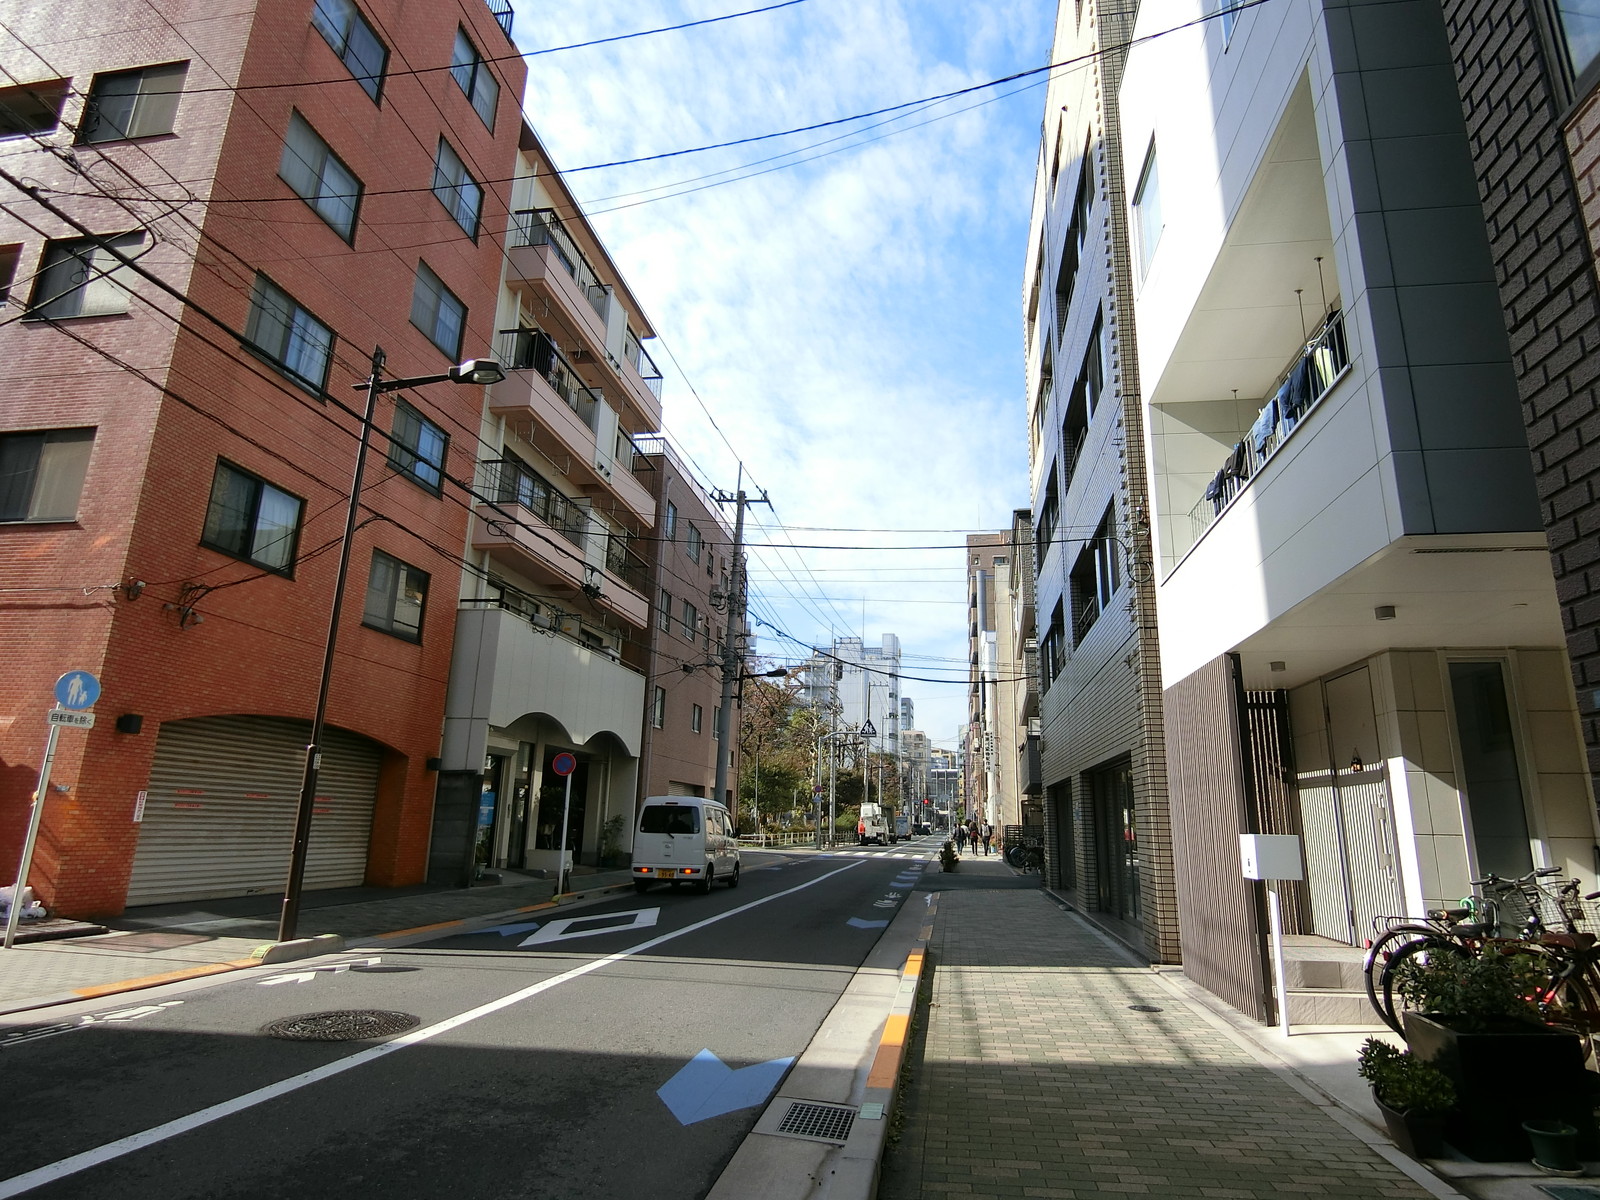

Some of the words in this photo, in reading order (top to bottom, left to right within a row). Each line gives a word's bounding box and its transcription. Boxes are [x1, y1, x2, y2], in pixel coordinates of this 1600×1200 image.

[51, 713, 92, 724] 自転車を除く
